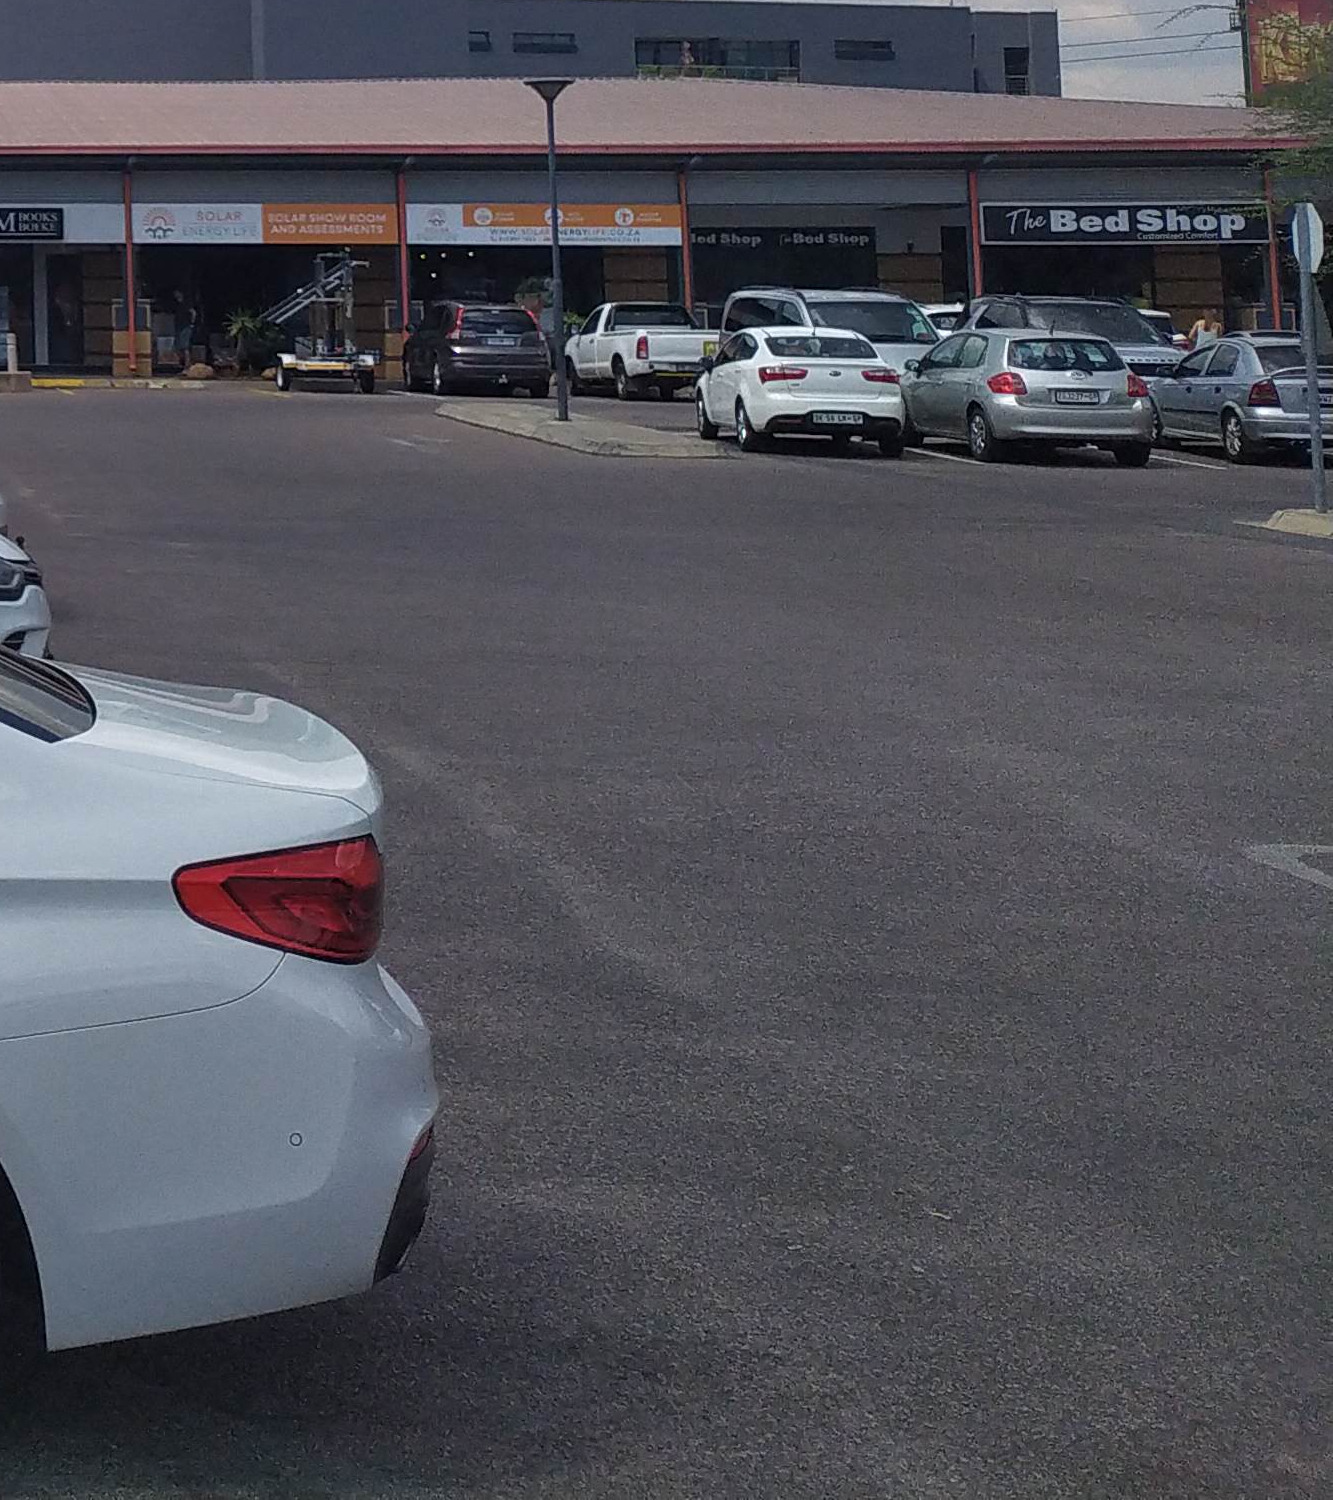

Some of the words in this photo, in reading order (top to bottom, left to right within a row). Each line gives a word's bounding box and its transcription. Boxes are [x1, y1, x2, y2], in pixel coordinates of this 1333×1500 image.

[18, 211, 58, 222] BOOKS
[196, 211, 242, 222] SOLAR
[268, 213, 308, 223] SOLAR
[309, 213, 347, 223] SHOW
[348, 213, 387, 223] ROOM
[1006, 208, 1046, 235] The
[1049, 209, 1130, 233] Bed
[1136, 208, 1246, 239] Shop
[270, 225, 297, 235] AND
[299, 225, 384, 235] ASSESSMENTS
[720, 233, 762, 247] Shop
[792, 232, 824, 244] Bed
[828, 233, 870, 246] Shop
